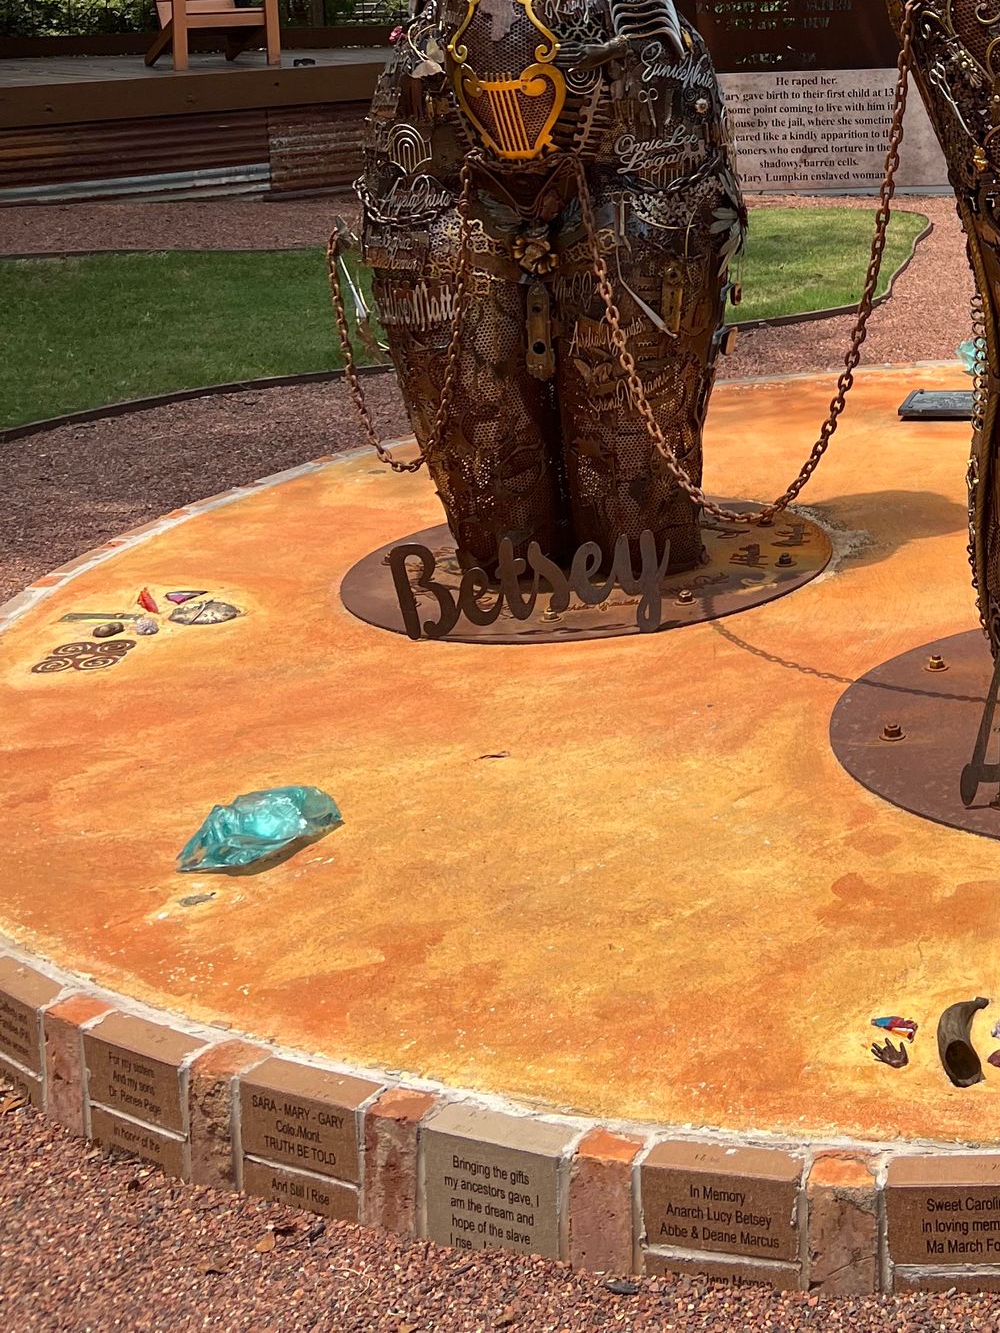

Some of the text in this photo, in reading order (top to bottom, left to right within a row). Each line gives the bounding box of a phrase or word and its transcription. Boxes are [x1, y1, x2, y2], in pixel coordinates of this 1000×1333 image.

[776, 76, 838, 87] He raped her.
[722, 93, 740, 103] ary
[743, 93, 764, 101] gave
[766, 91, 789, 100] birth
[792, 91, 800, 99] to
[803, 90, 824, 98] their
[827, 90, 845, 98] first
[847, 89, 870, 97] child
[872, 89, 881, 97] at
[760, 158, 859, 169] shadowy, barren cells.
[739, 174, 761, 185] Mary
[766, 173, 808, 183] Lumpkin
[811, 172, 849, 180] enslaved
[391, 529, 671, 640] Betsey
[252, 1095, 276, 1112] SARA
[284, 1104, 310, 1121] MARY
[319, 1113, 344, 1129] GARY
[264, 1135, 335, 1165] TRUTH BE TOLD
[453, 1155, 529, 1185] Bringing the gifts
[272, 1178, 329, 1205] And Still I Rise
[445, 1176, 458, 1190] my
[461, 1180, 505, 1199] ancestors
[537, 1195, 539, 1207] I
[690, 1185, 745, 1206] In Memory
[451, 1197, 534, 1226] am the dream and
[666, 1202, 772, 1230] Anarch Lucy Betsey
[927, 1198, 962, 1212] Sweet
[452, 1214, 475, 1231] hope
[478, 1222, 486, 1233] of
[489, 1224, 503, 1238] the
[660, 1222, 779, 1248] Abbe & Deane Marcus
[922, 1219, 932, 1232] in
[936, 1219, 968, 1235] loving
[450, 1233, 452, 1244] I
[927, 1240, 944, 1253] Ma
[948, 1239, 982, 1253] March
